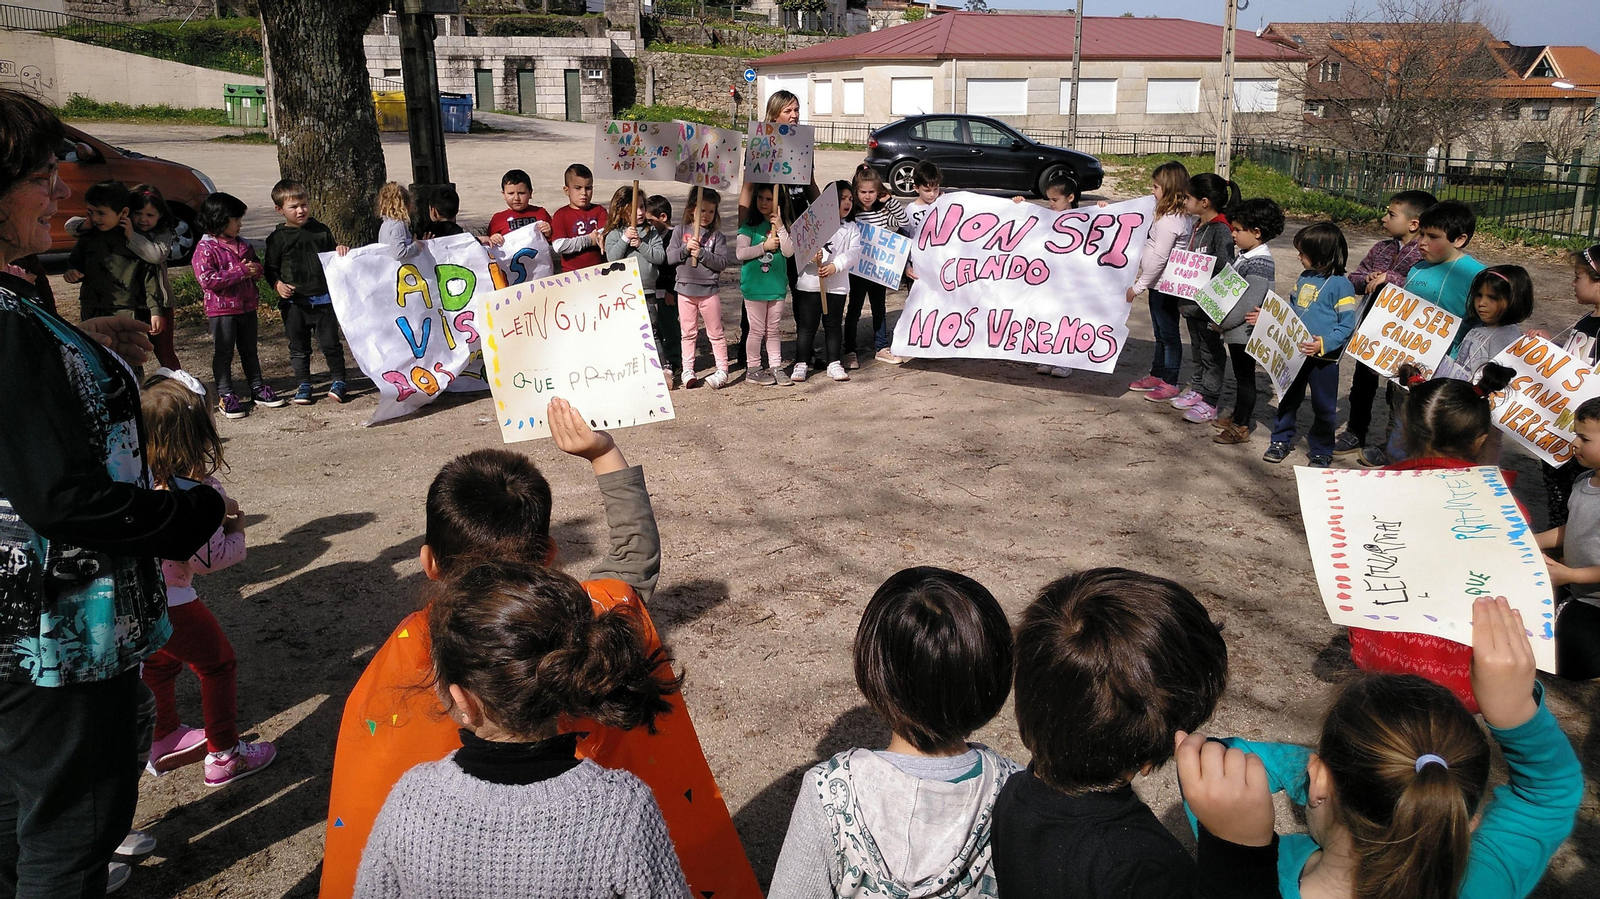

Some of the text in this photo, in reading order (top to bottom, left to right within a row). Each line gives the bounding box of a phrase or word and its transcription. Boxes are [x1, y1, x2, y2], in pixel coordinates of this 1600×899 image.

[606, 122, 660, 135] ADIOS
[610, 134, 641, 147] PARA
[678, 123, 719, 145] ADIOS
[755, 122, 798, 136] ADIOS
[676, 143, 710, 162] PARA
[750, 135, 783, 151] PARA
[678, 161, 727, 175] SEMPRE
[686, 172, 731, 190] ADIOS
[878, 228, 909, 255] SEI
[917, 202, 1146, 269] NON SEI
[939, 253, 1050, 292] CANDO
[1170, 249, 1189, 266] NON
[1188, 254, 1213, 272] SEI
[1173, 267, 1199, 280] CANDO
[858, 258, 901, 290] VEREMOS
[1159, 279, 1175, 294] NOS
[1223, 273, 1248, 297] SEI
[1263, 297, 1290, 326] NON
[1374, 286, 1455, 339] NON SEI
[987, 308, 1118, 363] VEREMOS
[1266, 324, 1295, 360] CANDO
[1347, 331, 1380, 361] NOS
[1381, 321, 1432, 355] CANDO
[1247, 337, 1271, 364] NOS
[1505, 337, 1572, 380] NON
[513, 371, 555, 394] QUE
[1511, 375, 1571, 415] CAND
[1498, 400, 1576, 463] VEREMOS
[1464, 570, 1492, 596] QUE
